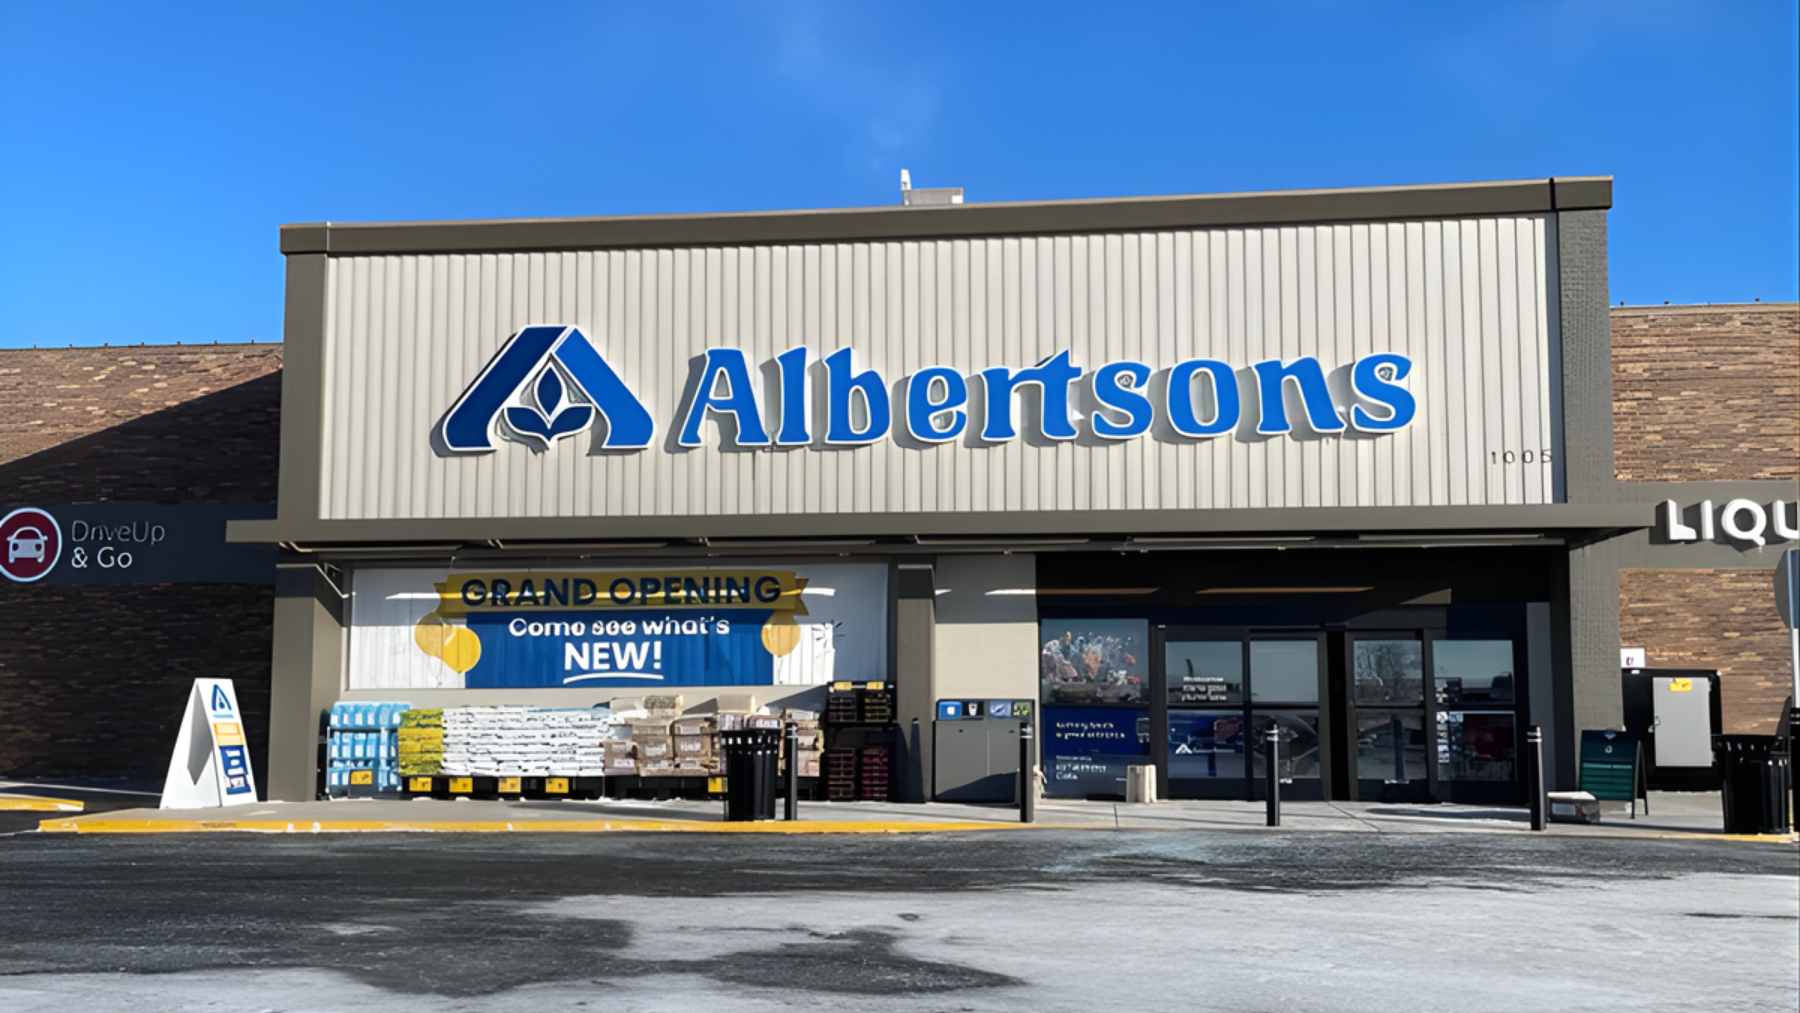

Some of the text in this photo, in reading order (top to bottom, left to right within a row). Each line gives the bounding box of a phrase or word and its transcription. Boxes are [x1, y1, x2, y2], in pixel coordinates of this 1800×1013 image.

[679, 346, 1417, 446] Albertsons
[1490, 448, 1552, 464] 1005
[71, 520, 165, 545] DriveUp
[71, 546, 132, 568] & Go
[461, 576, 782, 606] GRAND OPENING
[508, 615, 730, 637] Come see what's
[564, 641, 663, 670] NEW!
